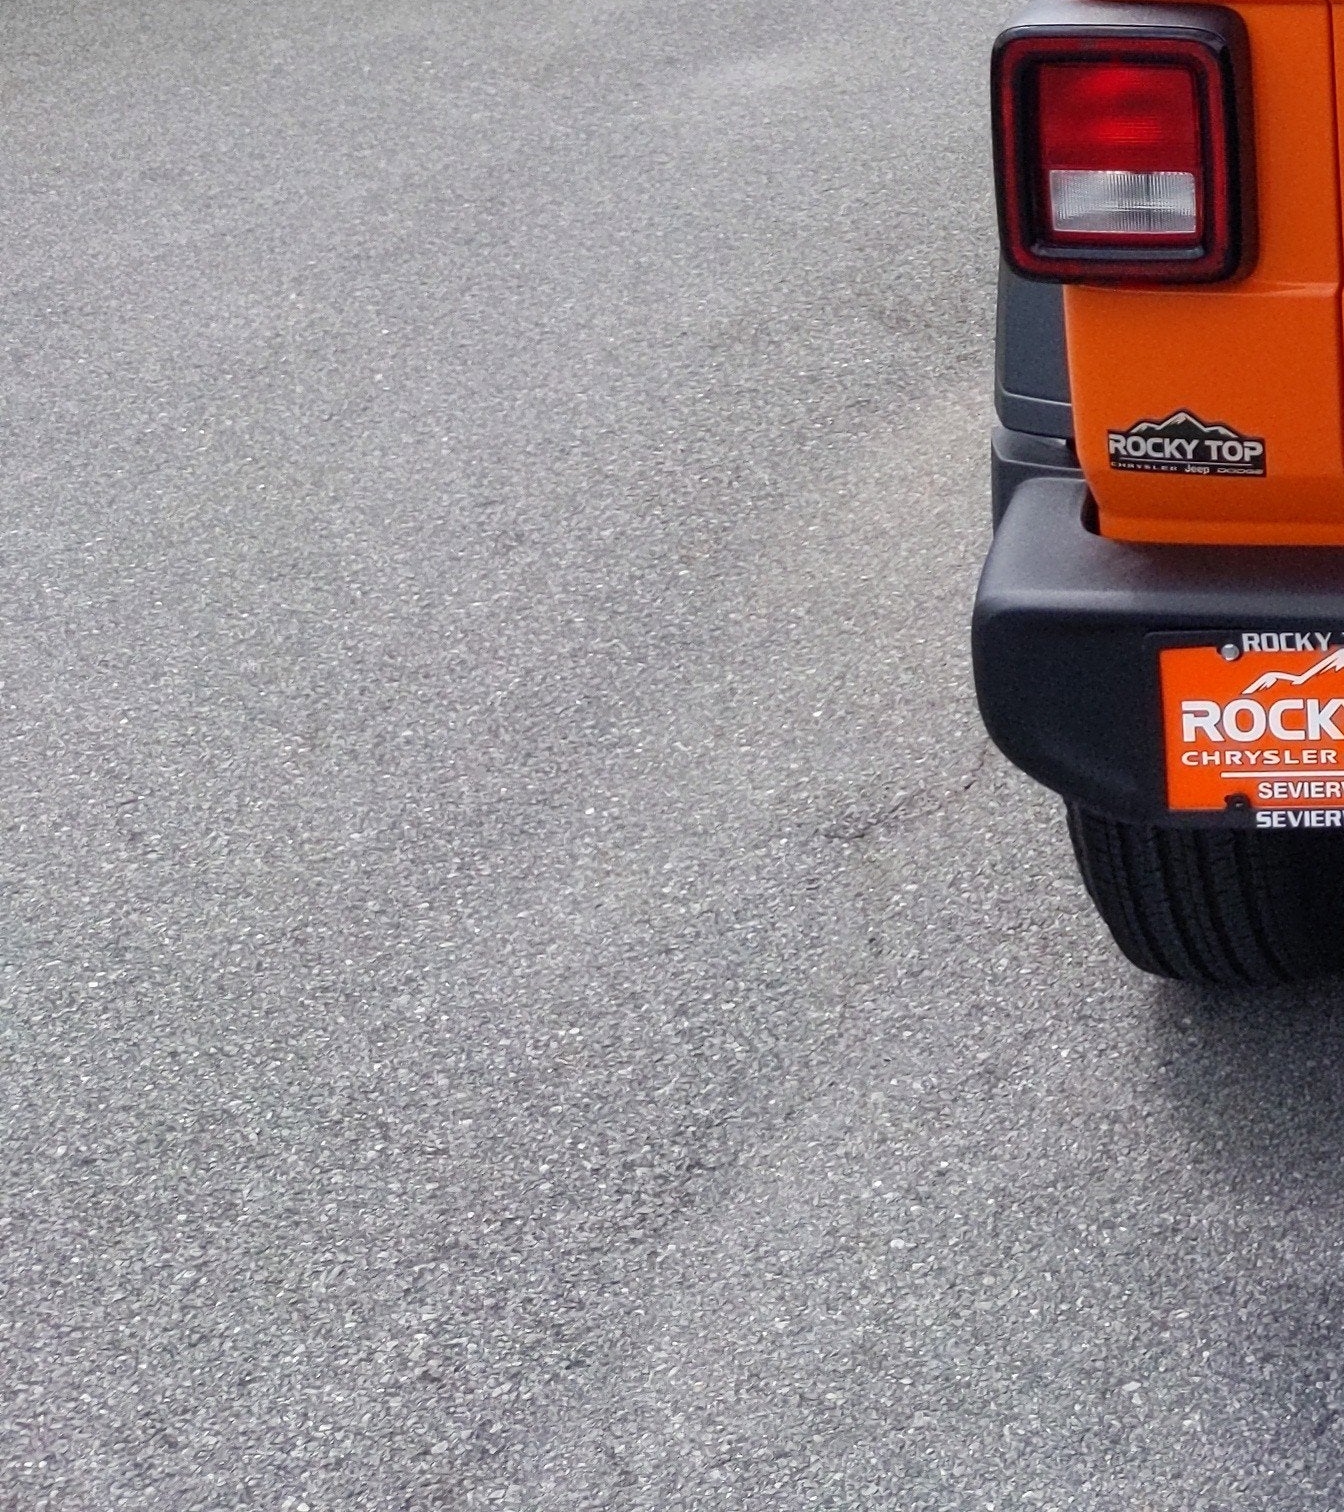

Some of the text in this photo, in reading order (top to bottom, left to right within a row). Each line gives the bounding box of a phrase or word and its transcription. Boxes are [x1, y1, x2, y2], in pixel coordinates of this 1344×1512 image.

[1108, 433, 1264, 462] ROCKY TOP
[1110, 461, 1264, 475] CHRYSLER Jeep DODGE
[1242, 631, 1332, 653] ROCKY
[1181, 748, 1338, 767] CHRYSLER
